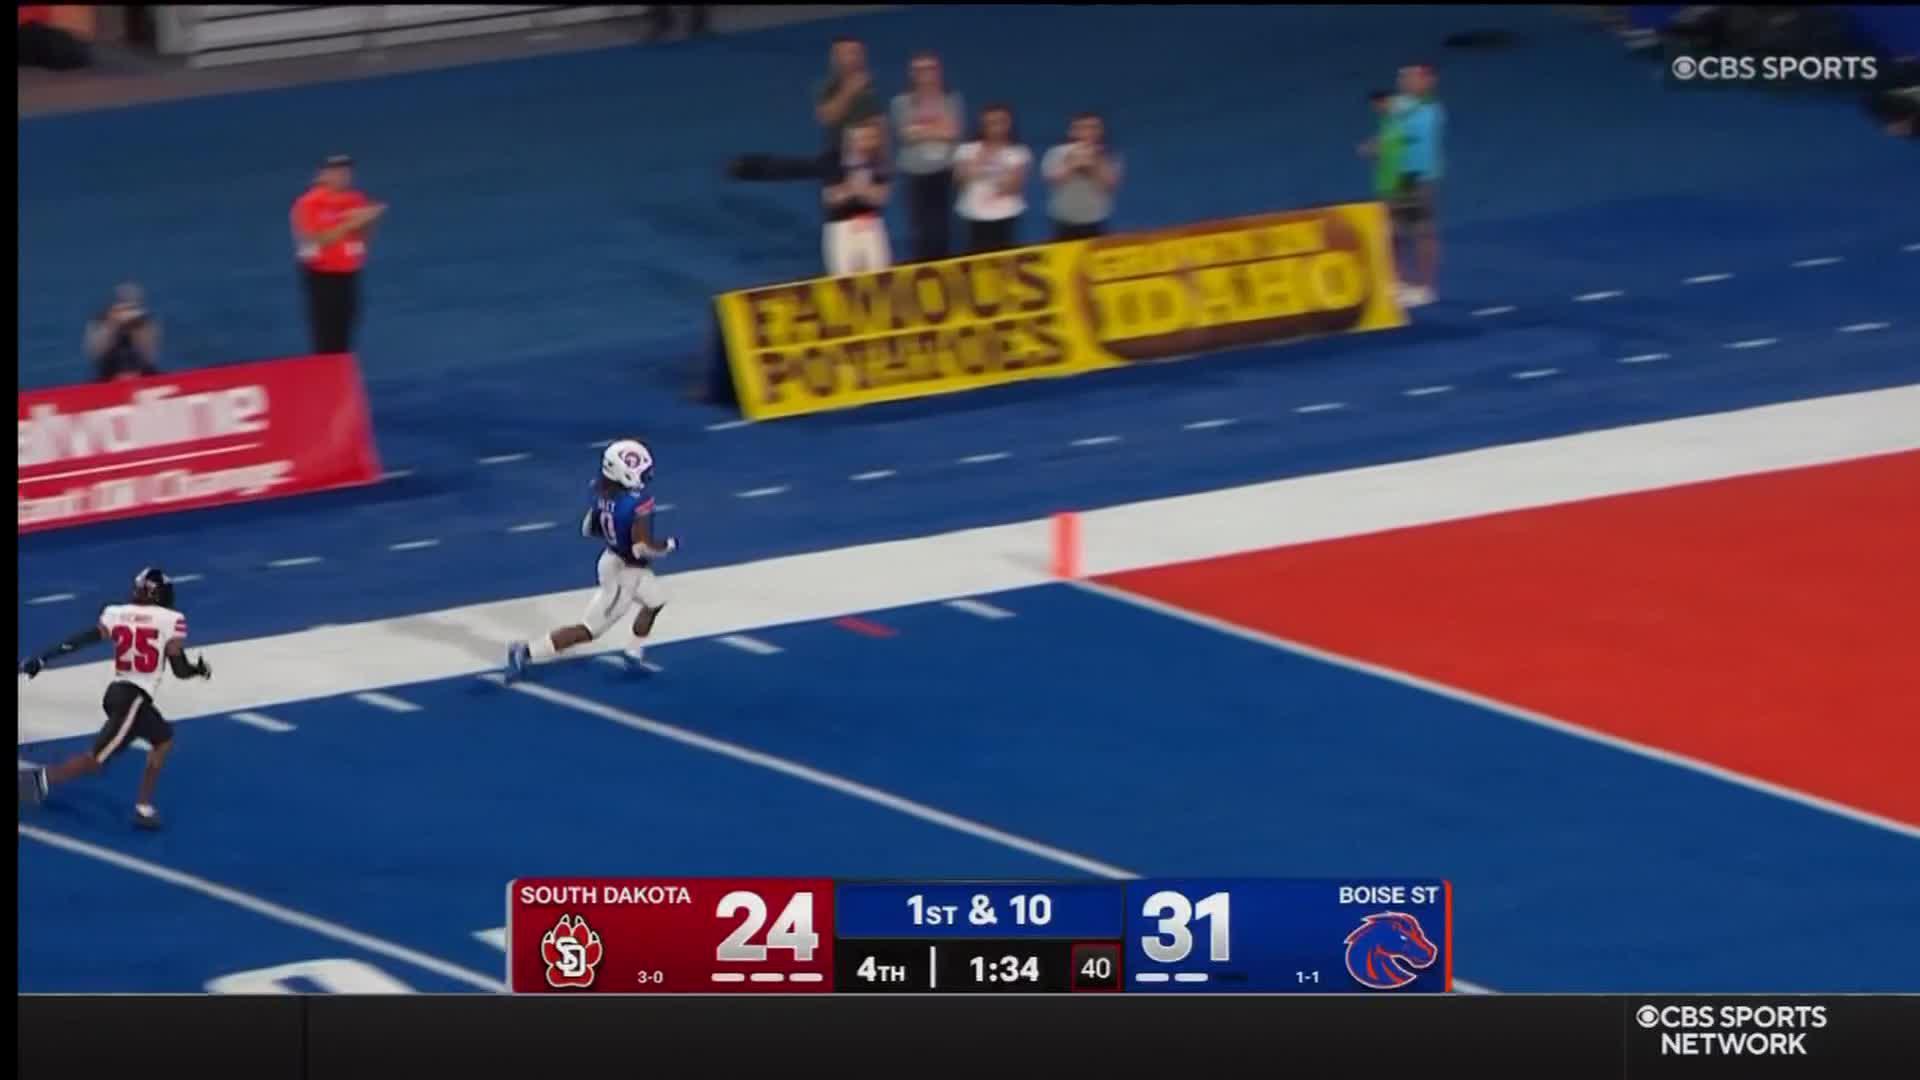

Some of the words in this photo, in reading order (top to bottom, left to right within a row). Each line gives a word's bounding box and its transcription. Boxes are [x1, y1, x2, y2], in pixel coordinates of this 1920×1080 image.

[748, 252, 1054, 347] FAMOUS
[1093, 249, 1362, 341] IDAHO
[758, 314, 1068, 405] POTATOES
[112, 625, 159, 673] 25
